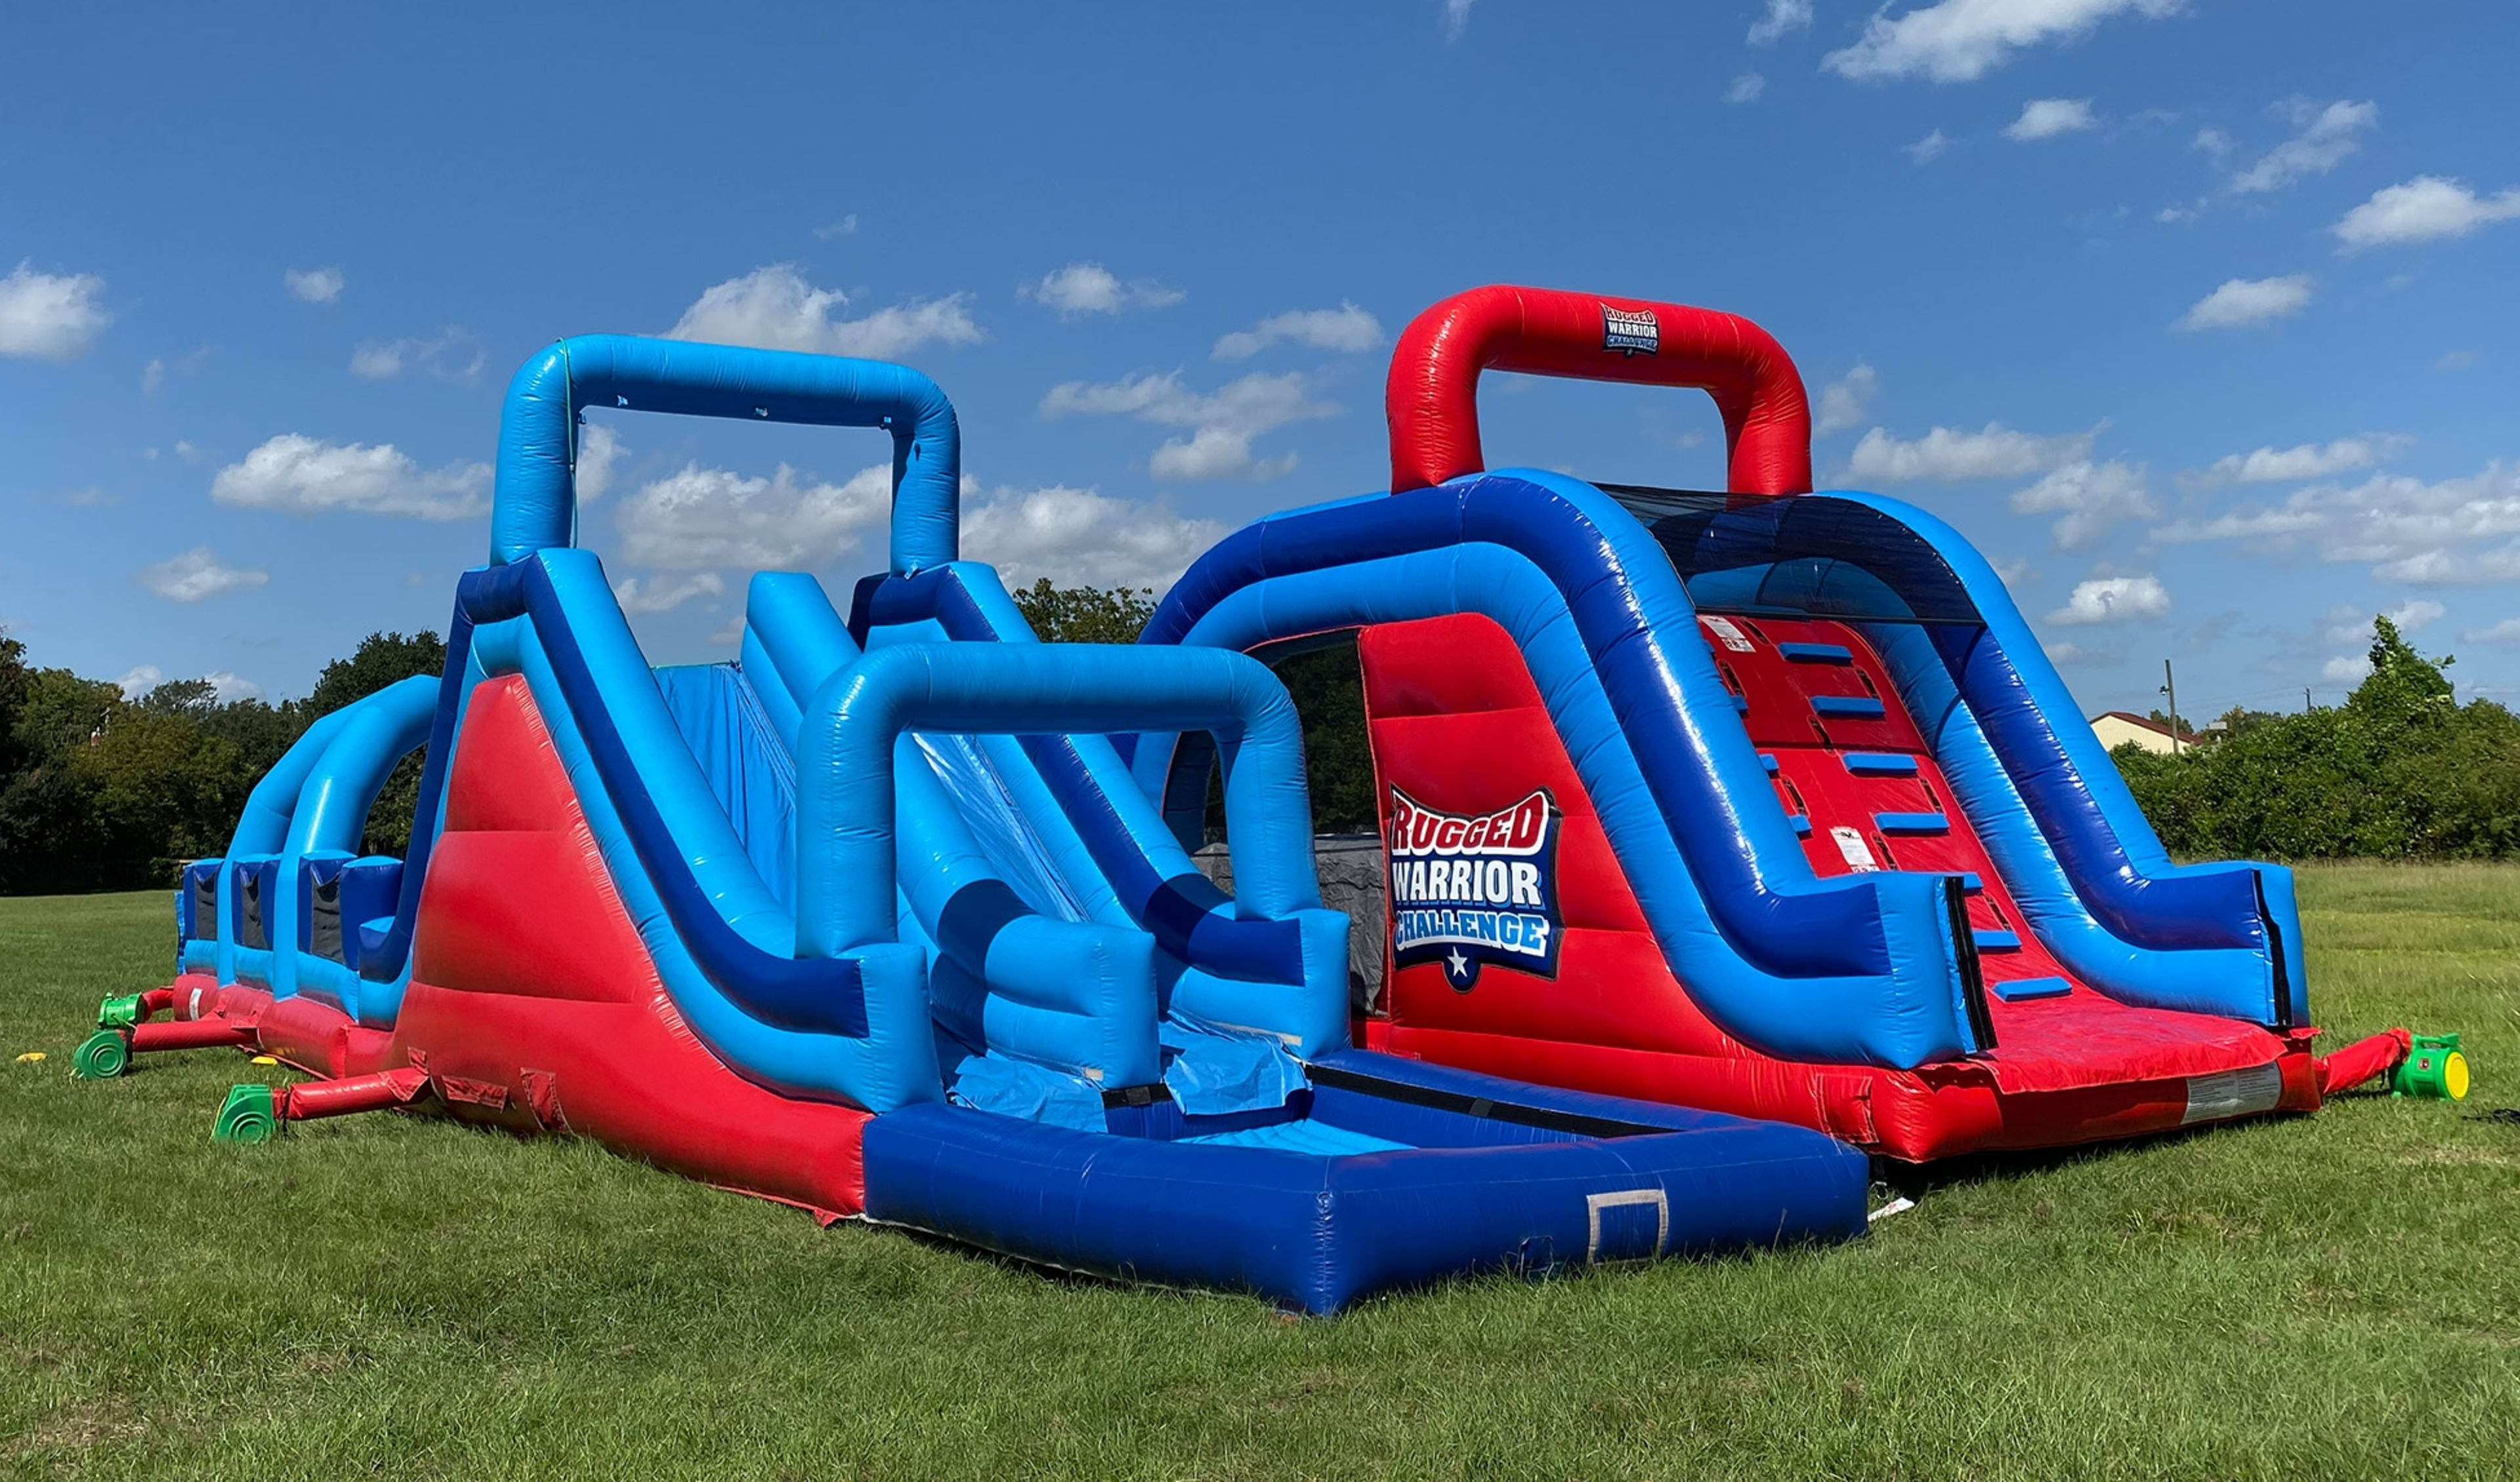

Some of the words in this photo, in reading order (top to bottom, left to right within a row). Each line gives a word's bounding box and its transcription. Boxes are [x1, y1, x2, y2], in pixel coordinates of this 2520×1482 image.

[1605, 307, 1656, 324] RUGGED
[1608, 322, 1657, 338] WARRIOR
[1392, 792, 1547, 855] RUGGED
[1392, 860, 1544, 908] WARRIOR
[1395, 910, 1549, 957] CHALLENGE
